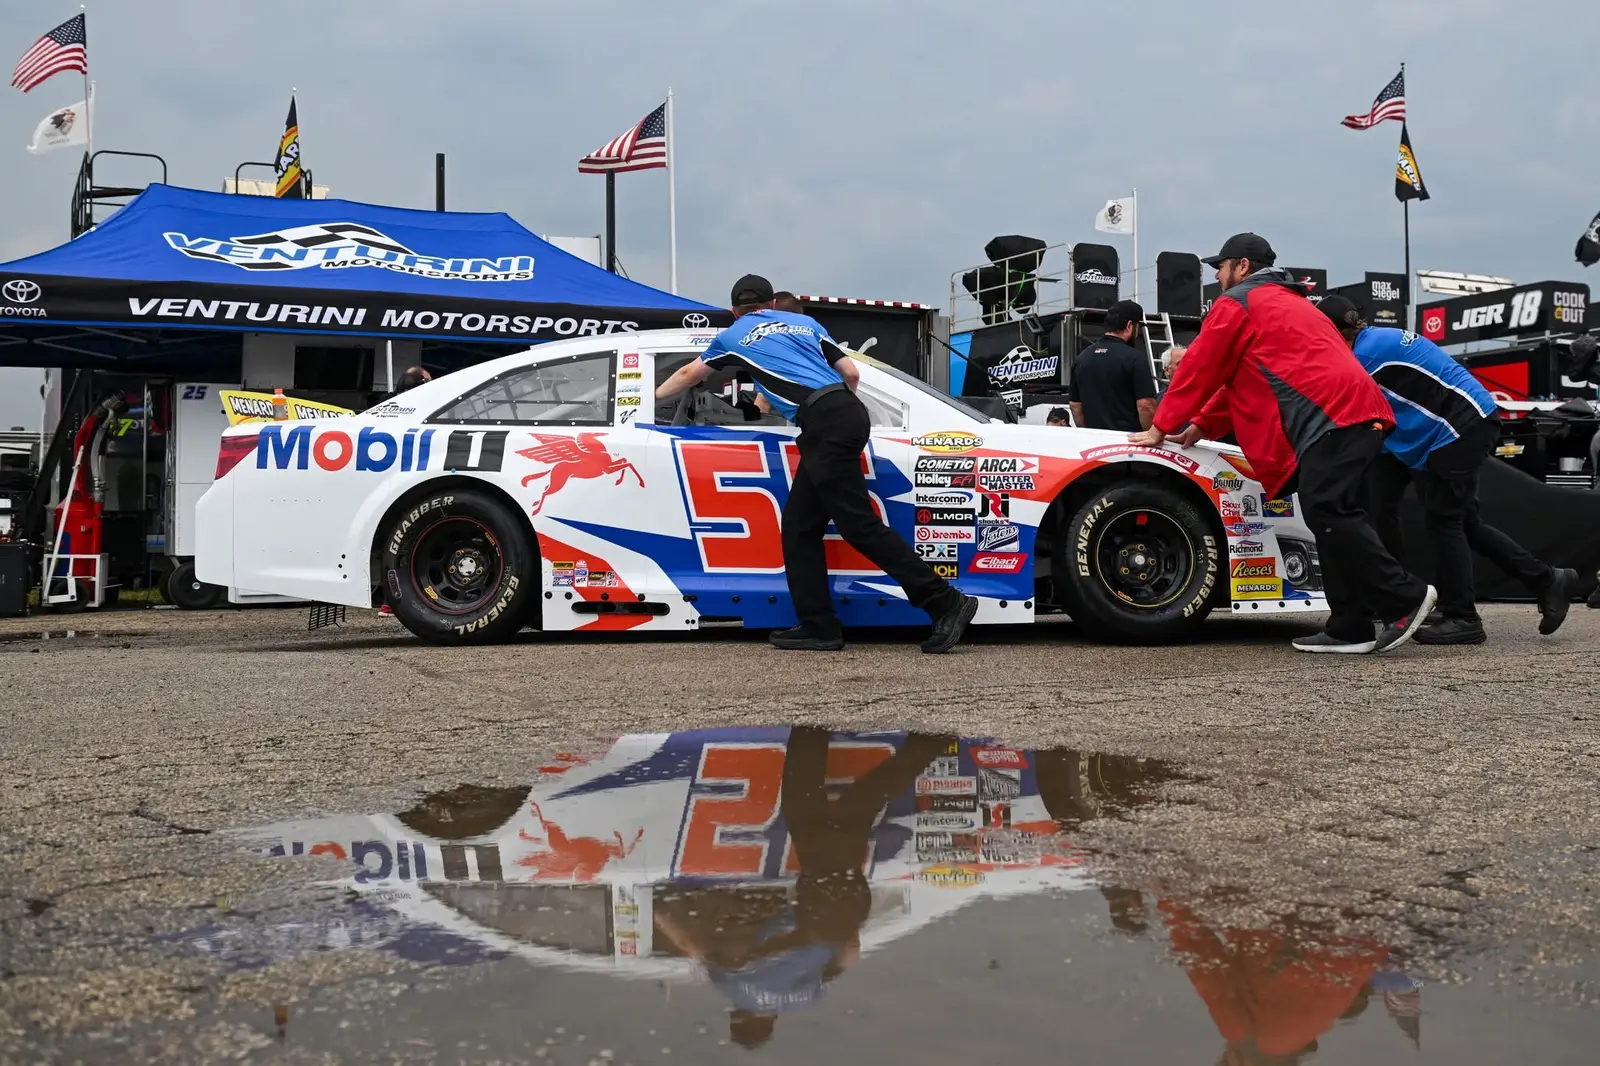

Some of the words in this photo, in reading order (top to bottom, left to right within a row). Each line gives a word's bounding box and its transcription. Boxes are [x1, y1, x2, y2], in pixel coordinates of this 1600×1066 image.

[163, 231, 535, 273] VENTURINI
[324, 258, 531, 281] MOTORSPORTS
[1371, 280, 1391, 290] max
[1554, 291, 1585, 308] COOK
[0, 306, 47, 317] TOYOTA
[129, 297, 366, 326] VENTURINI
[381, 310, 639, 336] MOTORSPORTS
[1452, 303, 1505, 331] JGR
[1508, 289, 1543, 329] 18
[988, 356, 1058, 377] VENTURINI
[1013, 369, 1056, 382] MOTORSPORTS
[183, 385, 208, 400] 25
[257, 425, 435, 472] Mobil
[911, 436, 984, 448] MENARDS
[1086, 445, 1143, 459] GENERAL
[1145, 445, 1172, 458] TIRE
[917, 459, 975, 470] COMETIC
[979, 459, 1017, 472] ARCA
[917, 474, 951, 487] Holley
[980, 475, 1031, 486] QUARTER
[1213, 477, 1242, 492] Bounty
[916, 494, 967, 505] Intercomp
[1222, 500, 1241, 509] Sioux
[388, 496, 454, 555] GRABBER
[933, 530, 972, 539] brembo
[1077, 497, 1114, 577] GENERAL
[1229, 542, 1264, 553] Richmond
[975, 556, 1018, 569] Eibach
[1231, 560, 1273, 577] Reese's
[1183, 535, 1218, 618] GRABBER
[1236, 584, 1278, 593] MENARDS
[454, 575, 520, 636] GENERAL
